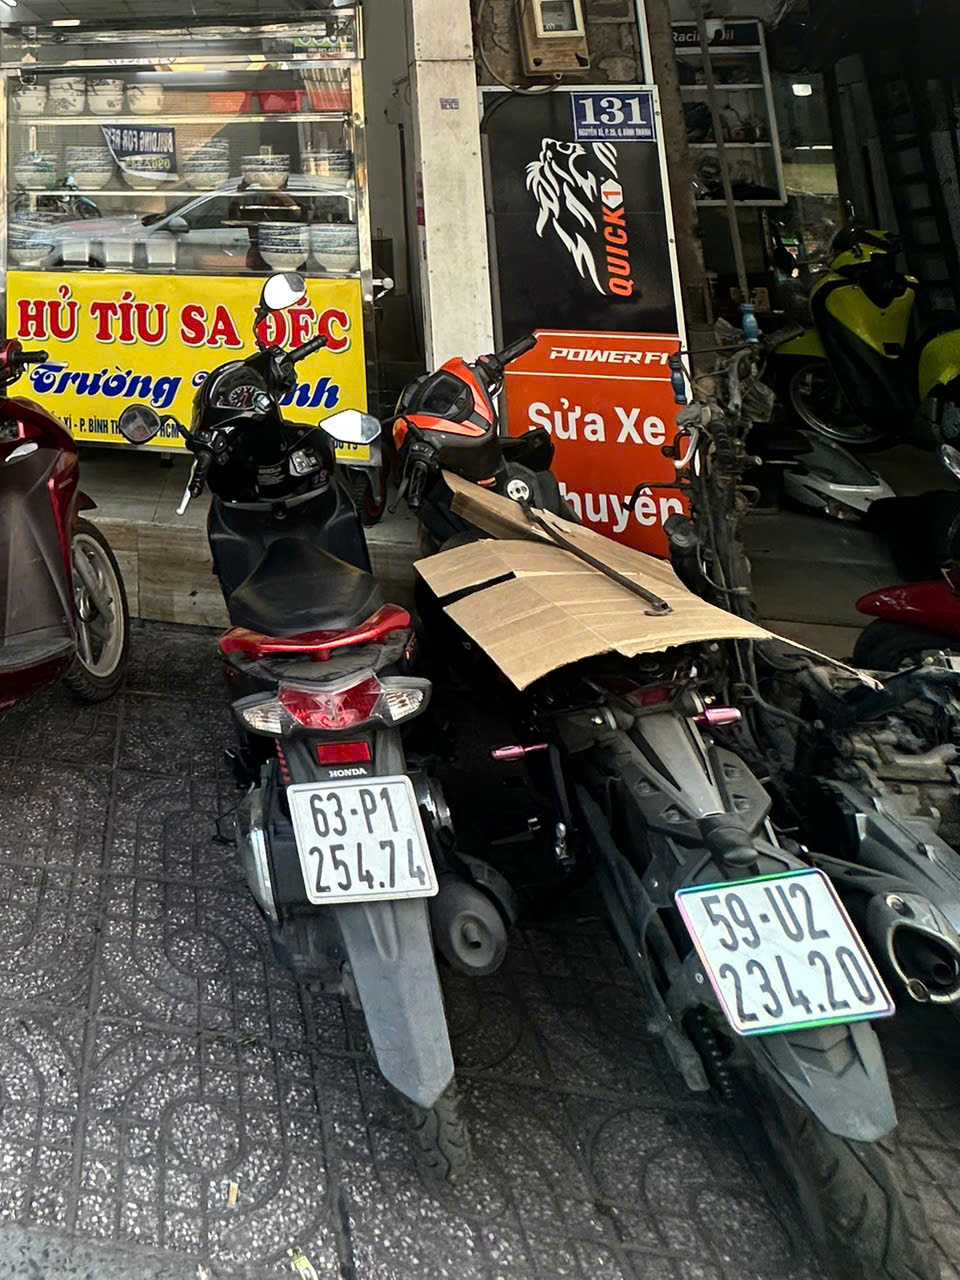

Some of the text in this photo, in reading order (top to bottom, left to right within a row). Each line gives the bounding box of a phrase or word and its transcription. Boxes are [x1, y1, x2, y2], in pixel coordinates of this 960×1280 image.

[579, 97, 647, 125] 131
[602, 207, 636, 297] QUICK
[15, 284, 79, 344] HỦ
[89, 290, 168, 347] TÍU
[180, 303, 244, 350] SA
[29, 362, 181, 408] Trường
[528, 397, 666, 446] Sửa Xe
[557, 481, 684, 534] huyên
[328, 766, 367, 778] HONDA
[309, 787, 399, 838] 63-P1
[308, 837, 427, 893] 254.74
[700, 883, 831, 952] 59-U2
[718, 945, 877, 1024] 234.20
